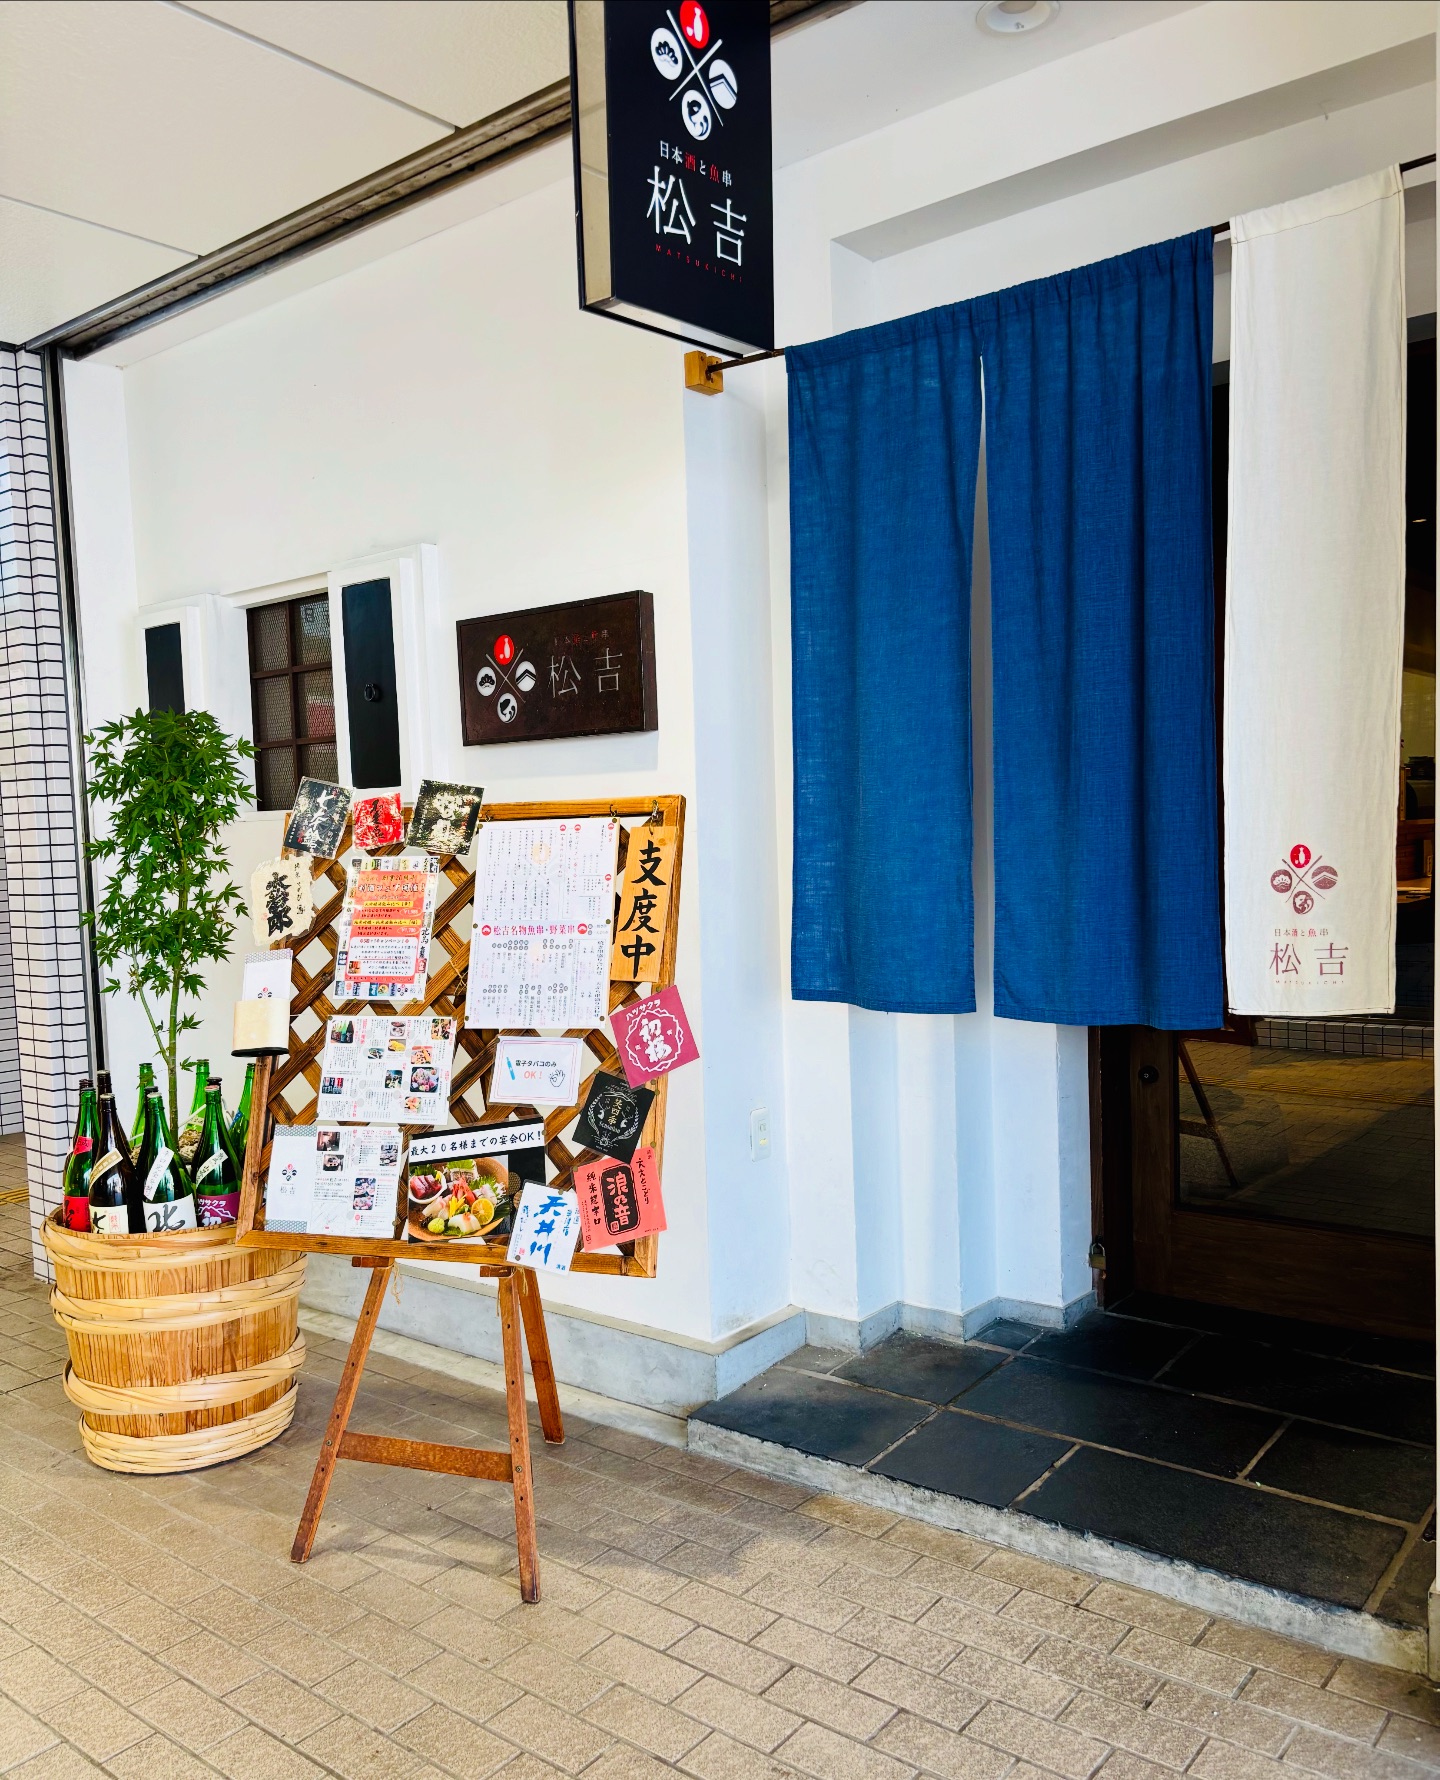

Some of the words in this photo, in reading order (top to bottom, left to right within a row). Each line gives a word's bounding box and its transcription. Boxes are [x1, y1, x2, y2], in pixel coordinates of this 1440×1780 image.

[659, 140, 732, 188] 日本酒と魚串
[645, 165, 748, 267] 松吉
[655, 243, 743, 283] MATSUKICHI
[546, 647, 623, 699] 松吉
[618, 839, 667, 980] 支度中
[493, 924, 575, 936] 松吉名物魚串・野菜串
[1274, 928, 1329, 937] 日本酒と魚串
[1269, 942, 1349, 976] 松吉
[625, 999, 661, 1021] ハツサクラ
[515, 1059, 557, 1068] 電子タバコのみ
[410, 1130, 542, 1157] 最大２０名様までの宴会OK！
[529, 1195, 568, 1266] 天井川
